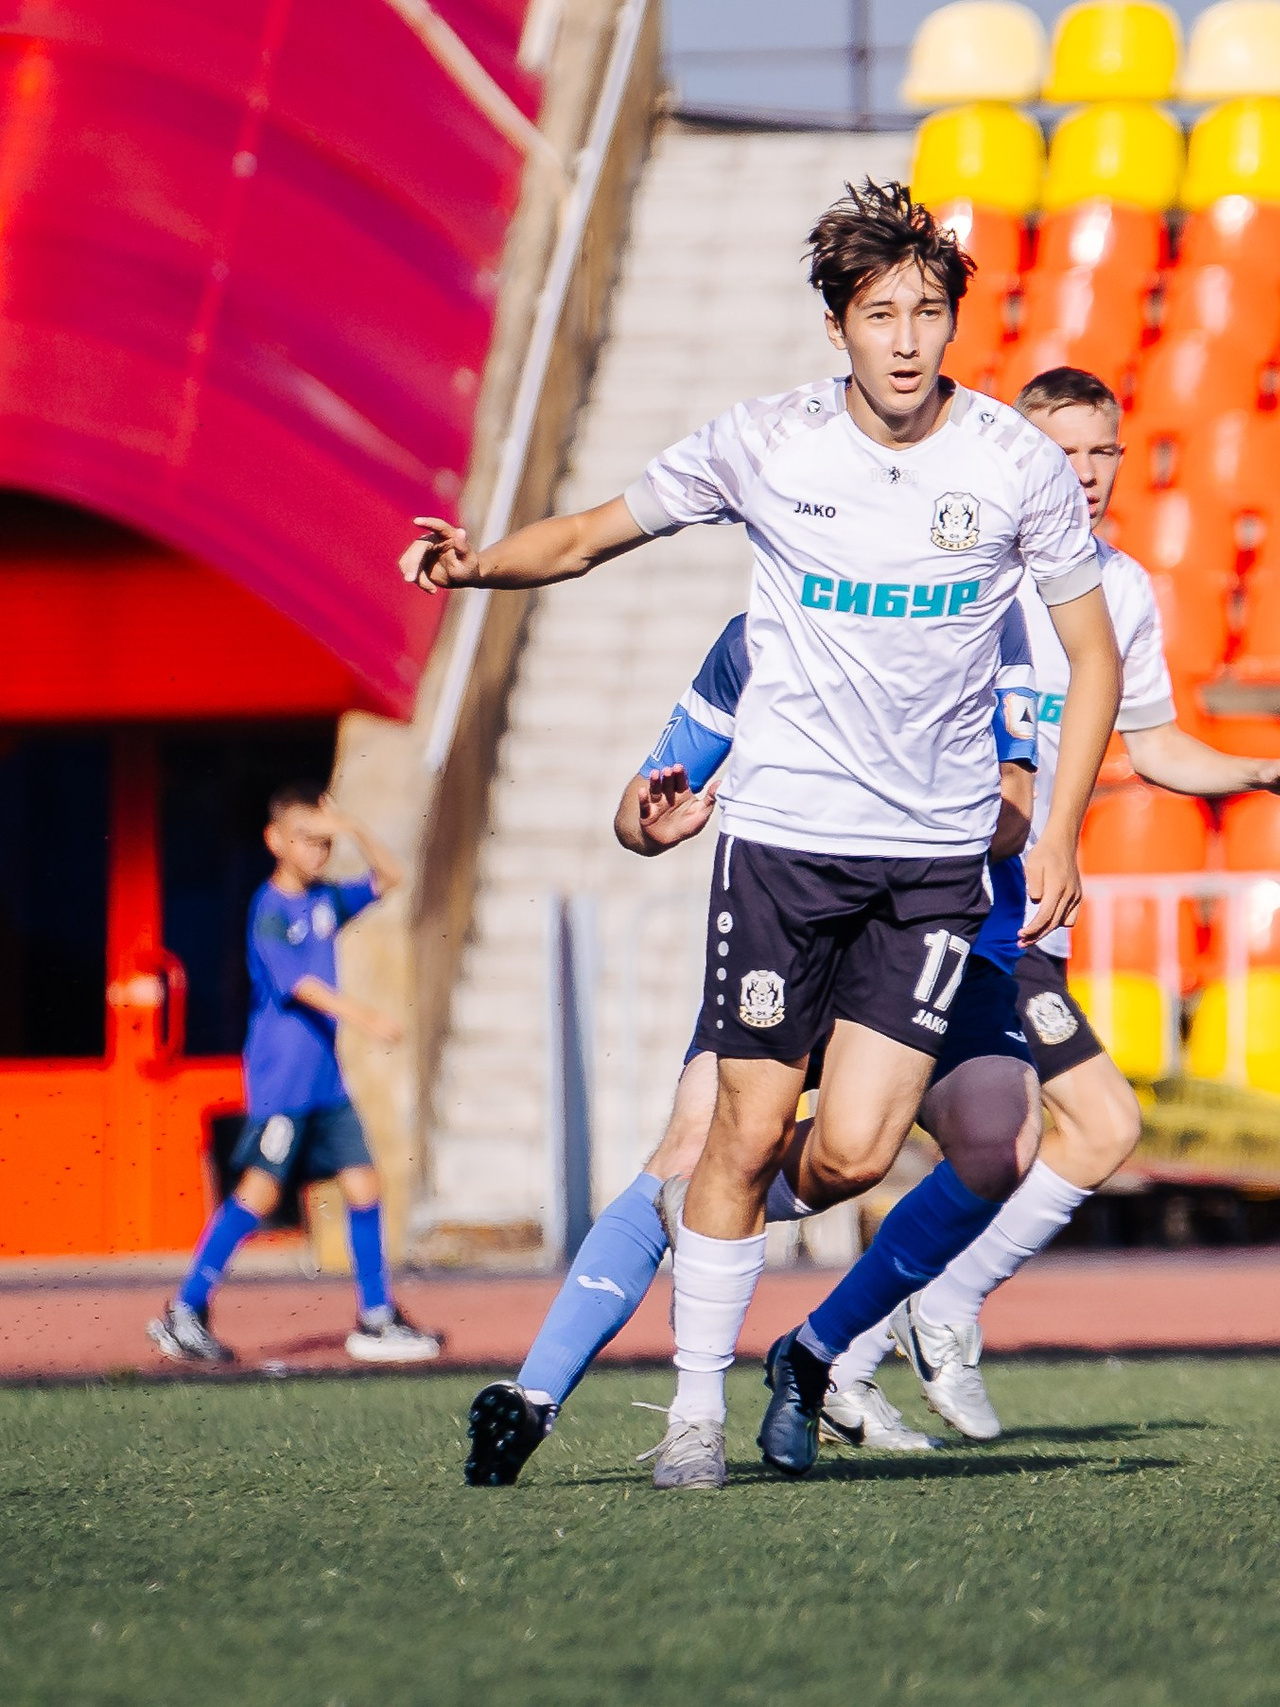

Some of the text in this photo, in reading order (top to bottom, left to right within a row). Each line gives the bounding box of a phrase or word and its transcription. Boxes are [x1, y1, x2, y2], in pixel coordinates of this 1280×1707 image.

[794, 501, 836, 518] JAKO
[801, 573, 980, 618] СИБУР
[913, 929, 970, 1011] 17
[912, 1009, 948, 1035] JAKO
